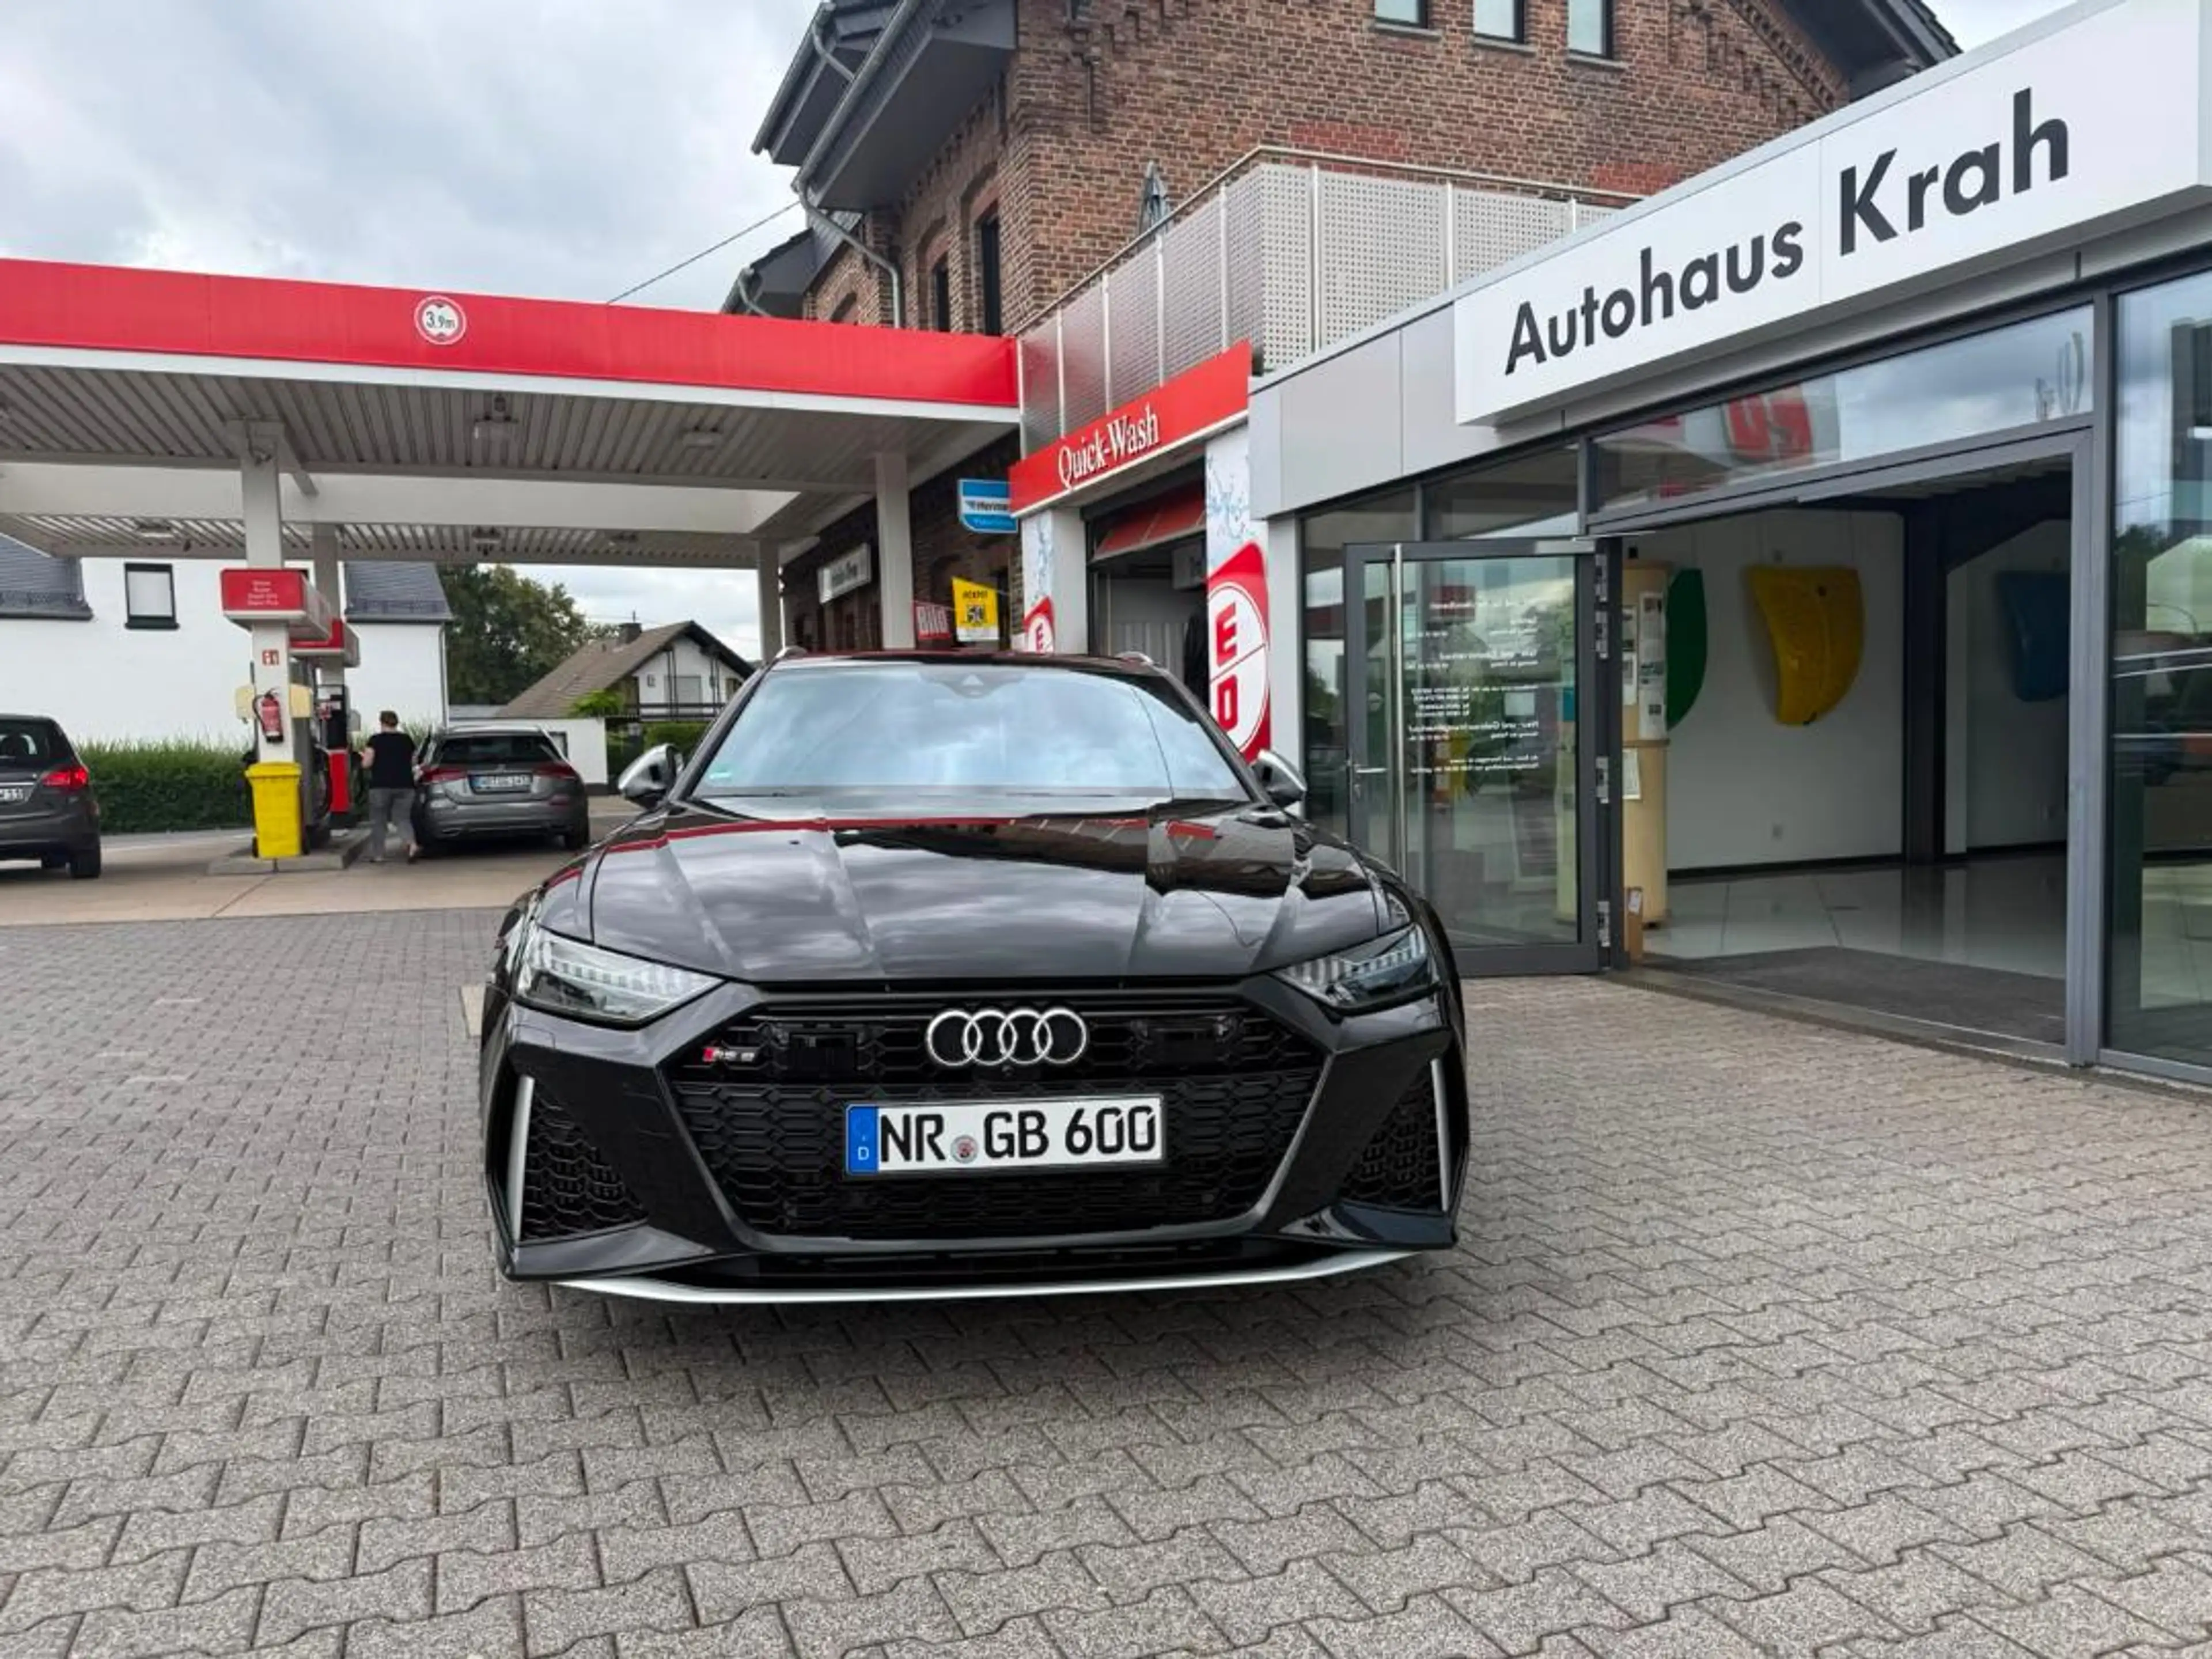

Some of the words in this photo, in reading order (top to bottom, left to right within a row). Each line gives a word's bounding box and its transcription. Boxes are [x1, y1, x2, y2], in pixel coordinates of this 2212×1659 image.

[1505, 221, 1804, 374] Autohaus
[1840, 87, 2069, 255] Krah
[1059, 402, 1159, 491] Quick-Wash
[858, 1147, 869, 1160] D
[880, 1113, 946, 1162] NR
[984, 1110, 1050, 1158] GB
[1065, 1106, 1156, 1155] 600
